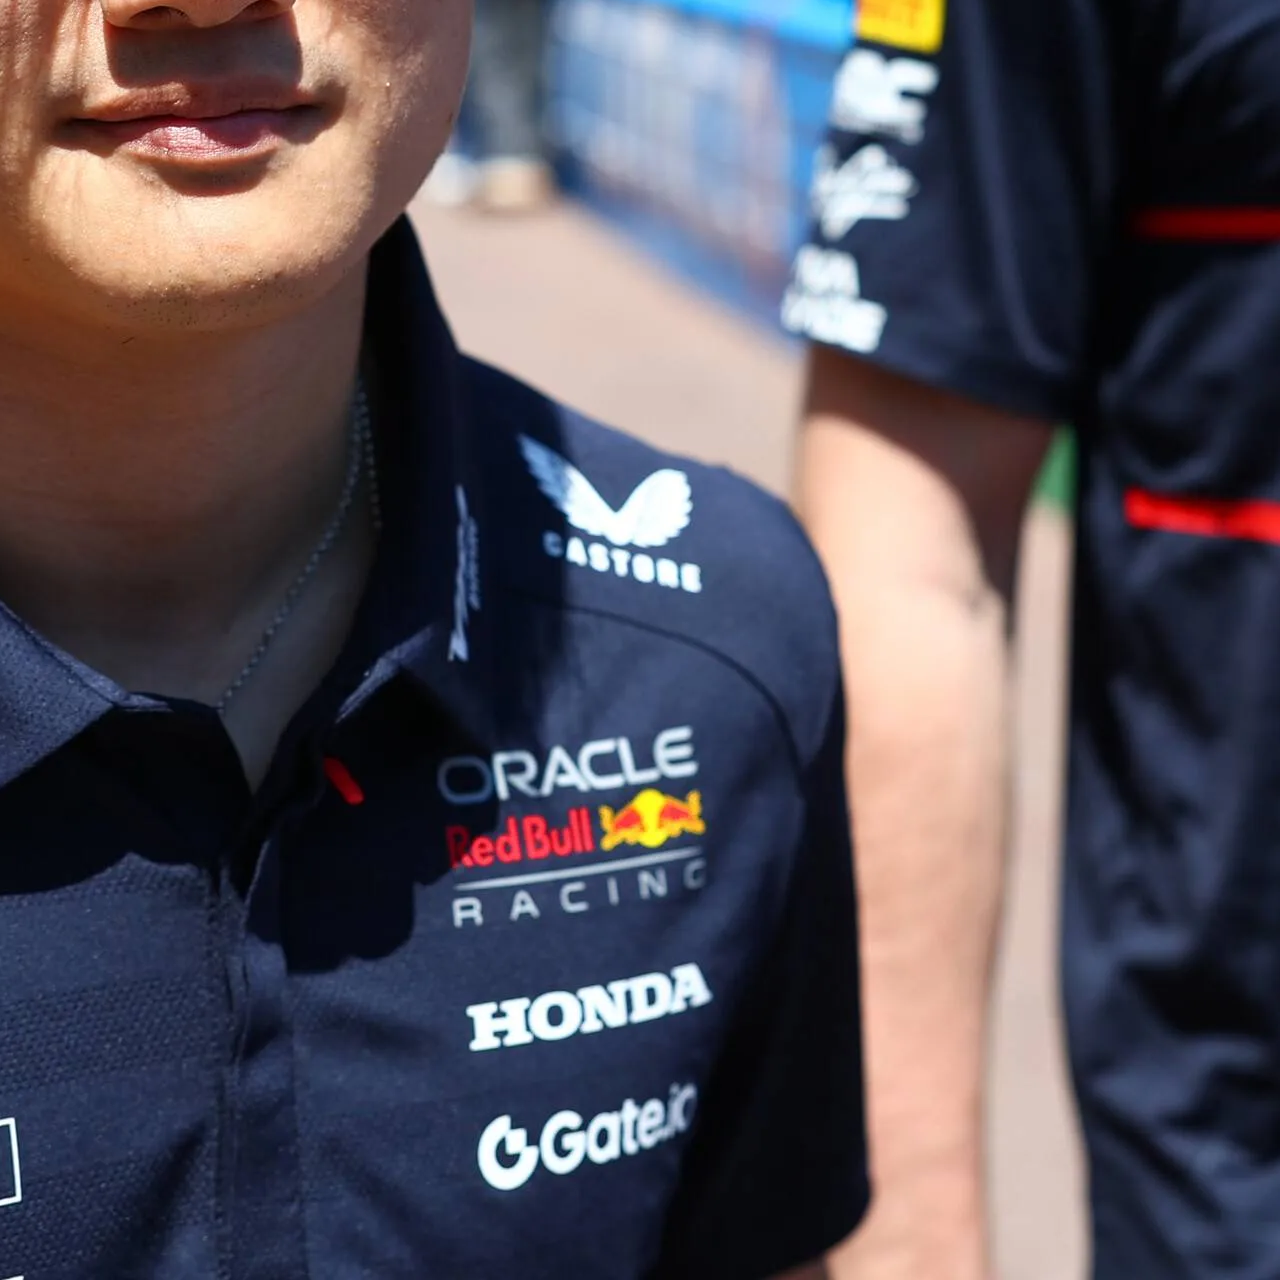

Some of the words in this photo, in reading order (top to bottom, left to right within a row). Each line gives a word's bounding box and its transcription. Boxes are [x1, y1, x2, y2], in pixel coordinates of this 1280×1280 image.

[542, 530, 703, 594] CASTORE
[437, 724, 699, 805] ORACLE
[452, 858, 706, 928] RACING
[466, 962, 713, 1051] HONDA
